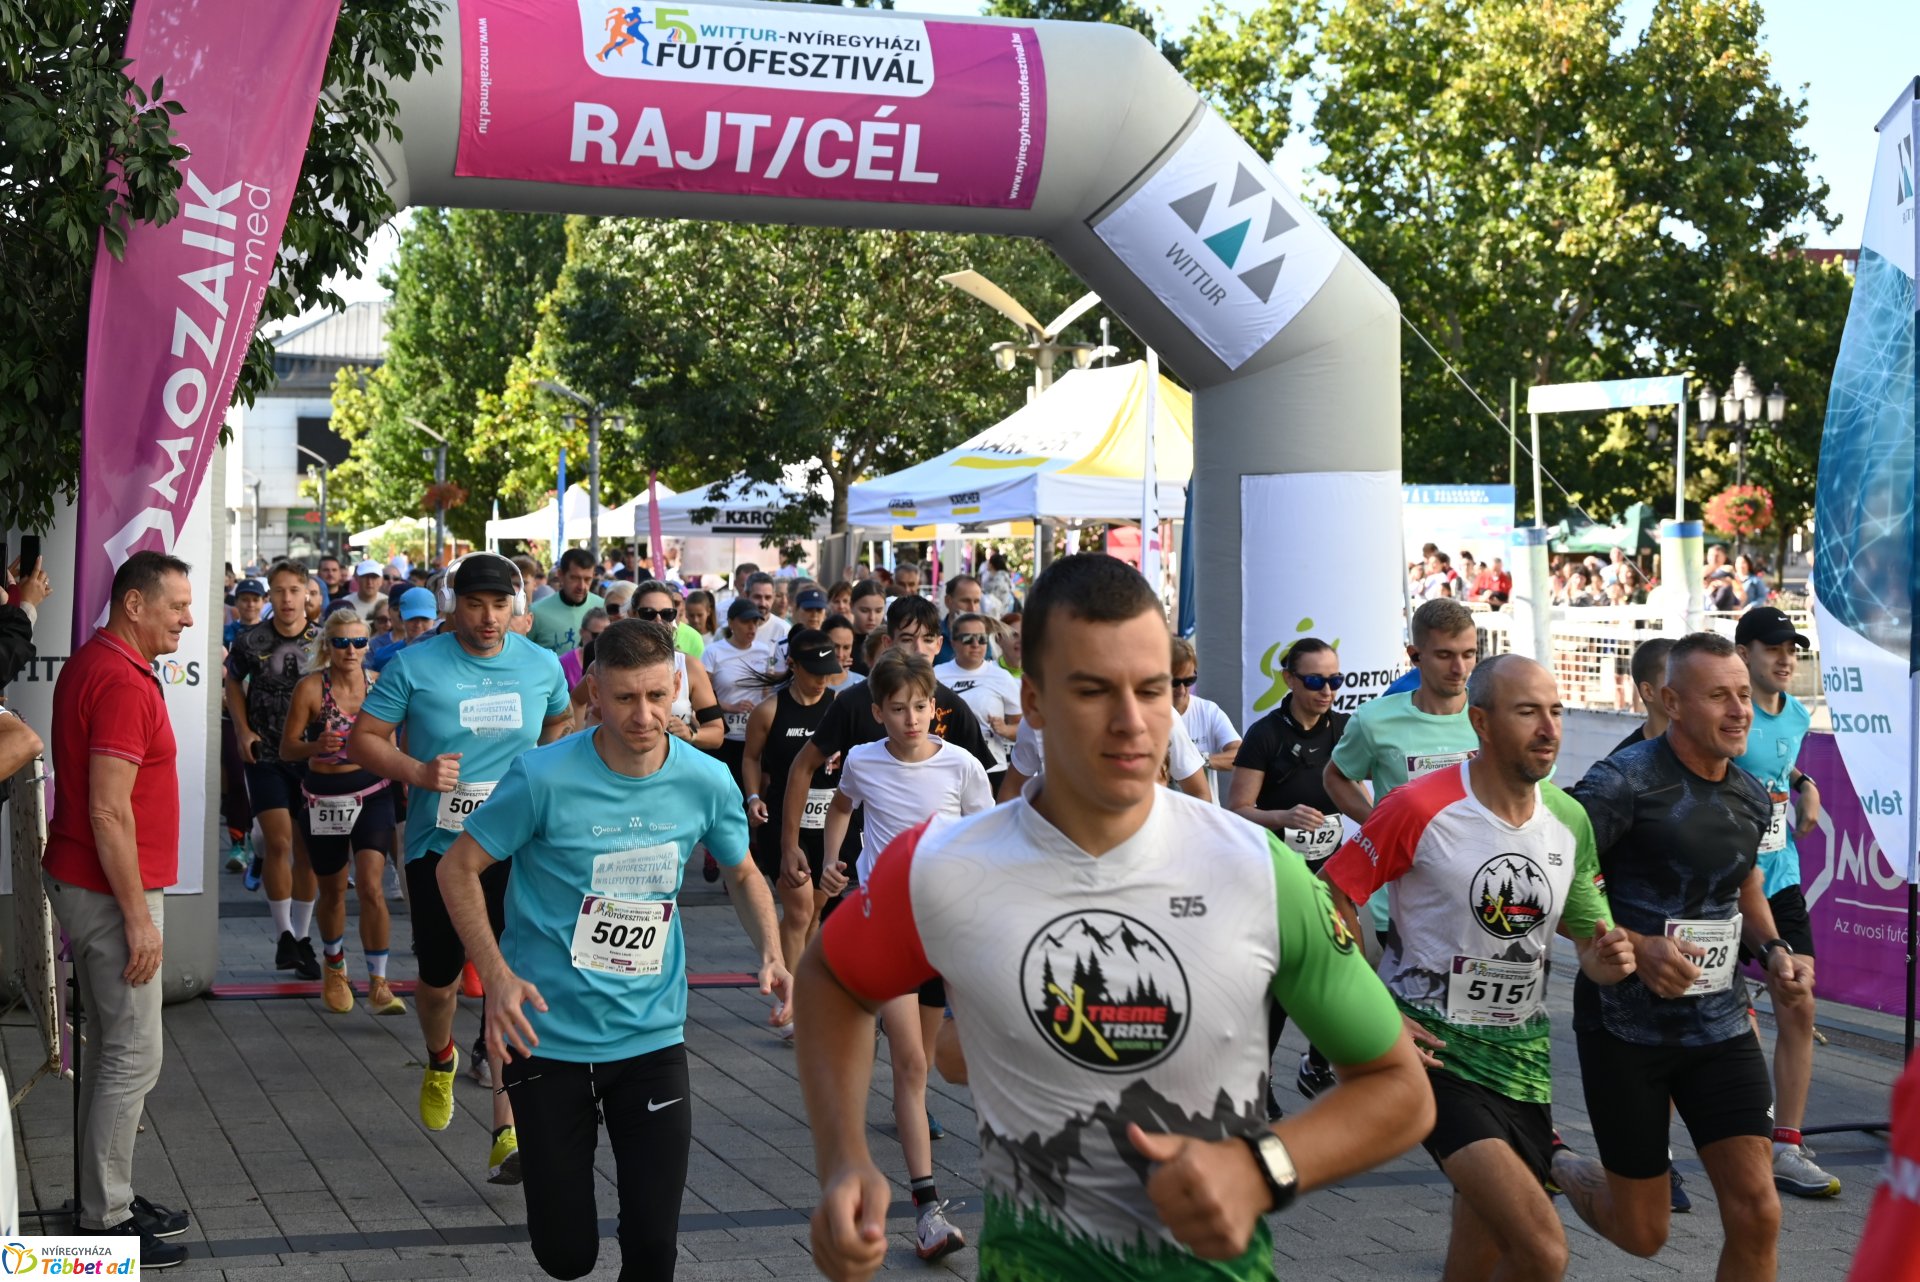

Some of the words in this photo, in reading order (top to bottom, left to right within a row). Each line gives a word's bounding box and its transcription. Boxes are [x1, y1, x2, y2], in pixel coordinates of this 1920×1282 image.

[655, 7, 697, 44] 5
[700, 24, 921, 52] WITTUR-NYÍREGYHÁZI
[478, 17, 491, 134] www.mozaikmed.hu
[656, 42, 924, 85] FUTÓFESZTIVÁL
[1009, 32, 1031, 200] www.nyiregyhazifutofesztival.hu
[570, 101, 939, 184] RAJT/CÉL
[244, 182, 271, 275] med
[1165, 242, 1227, 307] WITTUR
[148, 167, 243, 505] MOZAIK
[954, 680, 976, 688] NIKE
[728, 714, 747, 725] 516
[786, 728, 805, 737] NIKE
[319, 808, 355, 822] 5117
[805, 802, 830, 815] 069
[1295, 829, 1335, 845] 5182
[591, 920, 656, 950] 5020
[1834, 917, 1850, 933] Az
[1102, 1023, 1169, 1039] TRAIL
